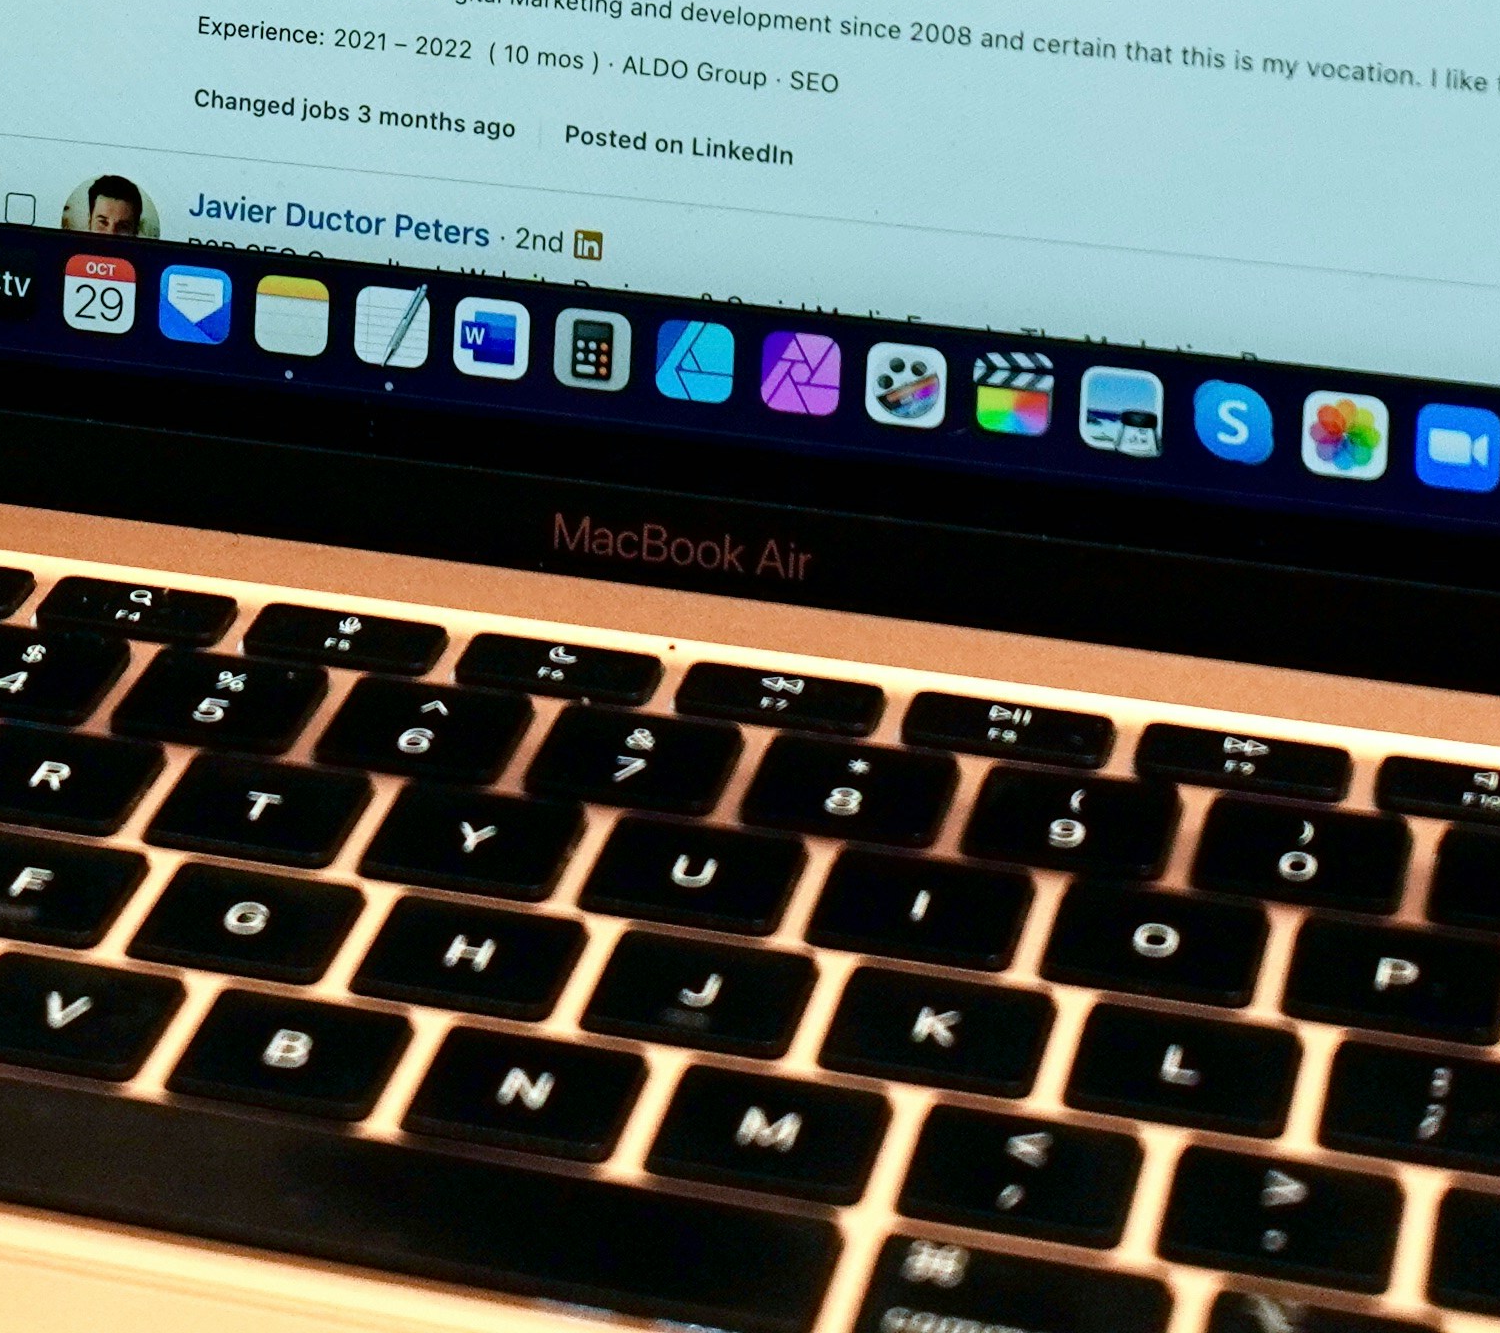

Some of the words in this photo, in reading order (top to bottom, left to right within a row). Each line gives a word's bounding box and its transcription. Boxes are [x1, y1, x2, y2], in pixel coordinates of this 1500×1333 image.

[194, 88, 295, 118] Changed
[300, 97, 350, 122] jobs
[357, 104, 371, 124] 3
[379, 110, 466, 133] months
[473, 119, 516, 141] ago
[565, 124, 647, 151] Posted
[654, 137, 683, 155] on
[692, 136, 794, 166] LinkedIn
[188, 192, 278, 225] Javier
[285, 202, 387, 236] Ductor
[394, 213, 490, 248] Peters
[515, 226, 564, 254] 2nd
[2, 270, 32, 298] tv
[85, 261, 117, 277] OCT
[74, 283, 124, 322] 29
[553, 511, 745, 573] MacBook
[755, 538, 813, 581] Air
[27, 758, 73, 793] R
[246, 788, 283, 823] T
